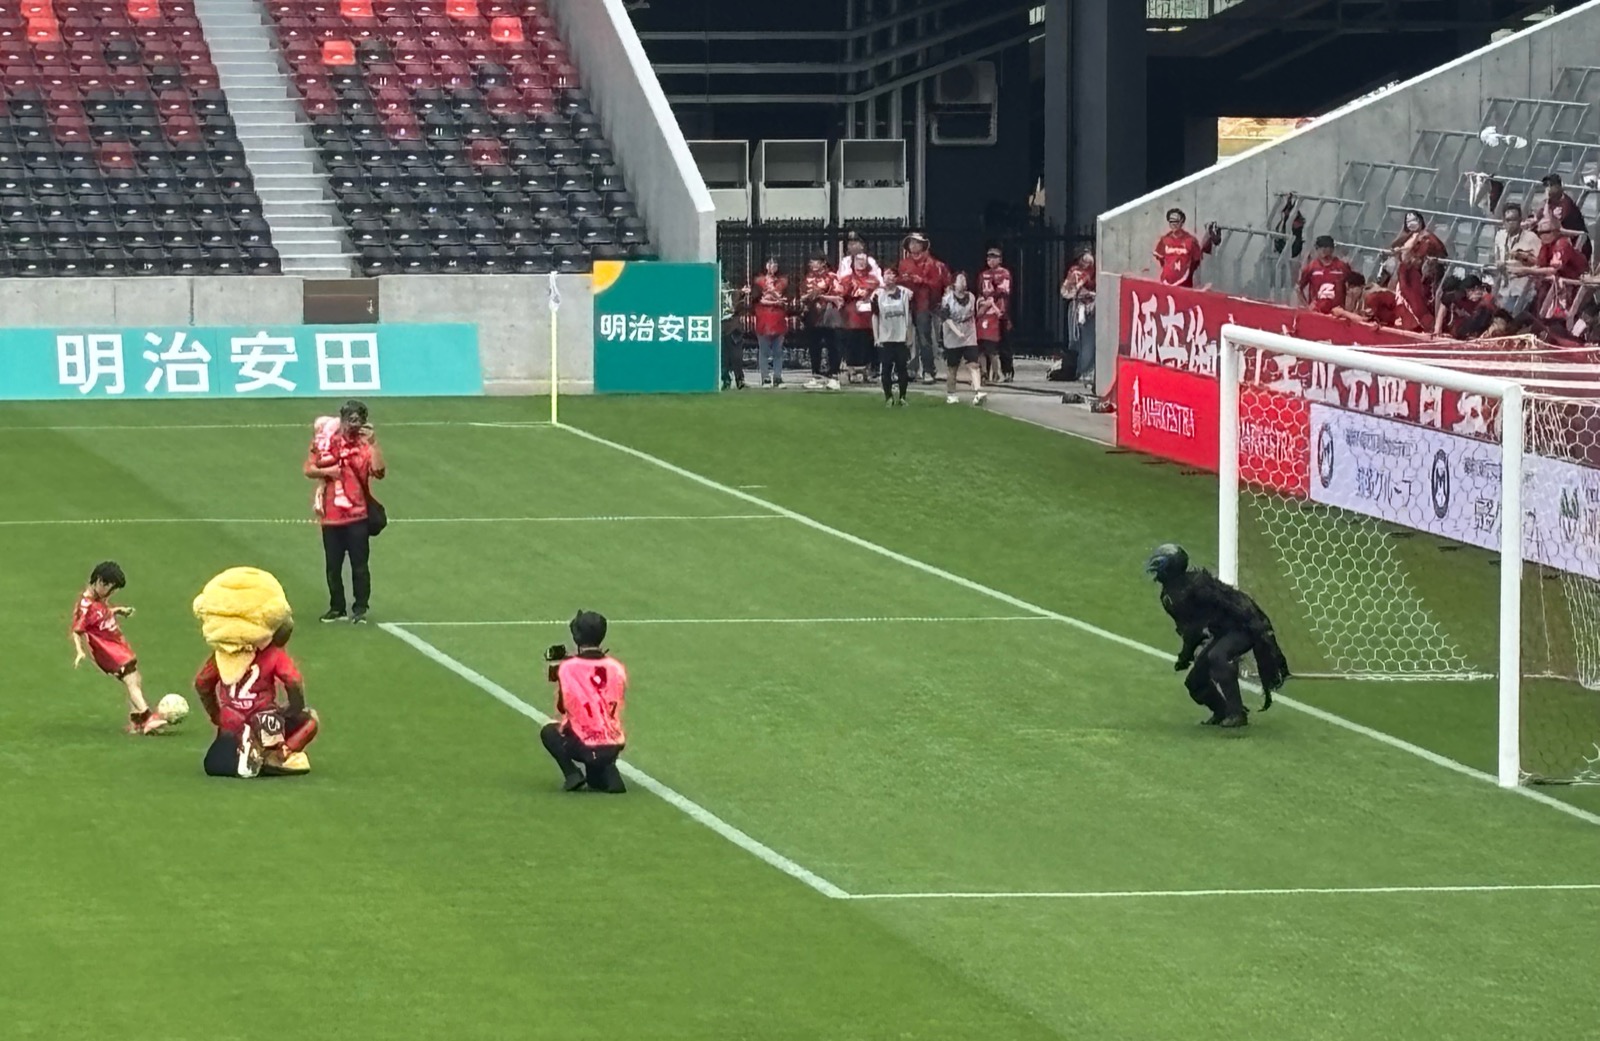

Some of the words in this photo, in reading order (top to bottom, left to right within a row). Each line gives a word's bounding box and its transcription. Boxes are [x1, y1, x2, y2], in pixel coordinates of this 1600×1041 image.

[600, 313, 713, 342] 明治安田
[56, 331, 381, 394] 明治安田
